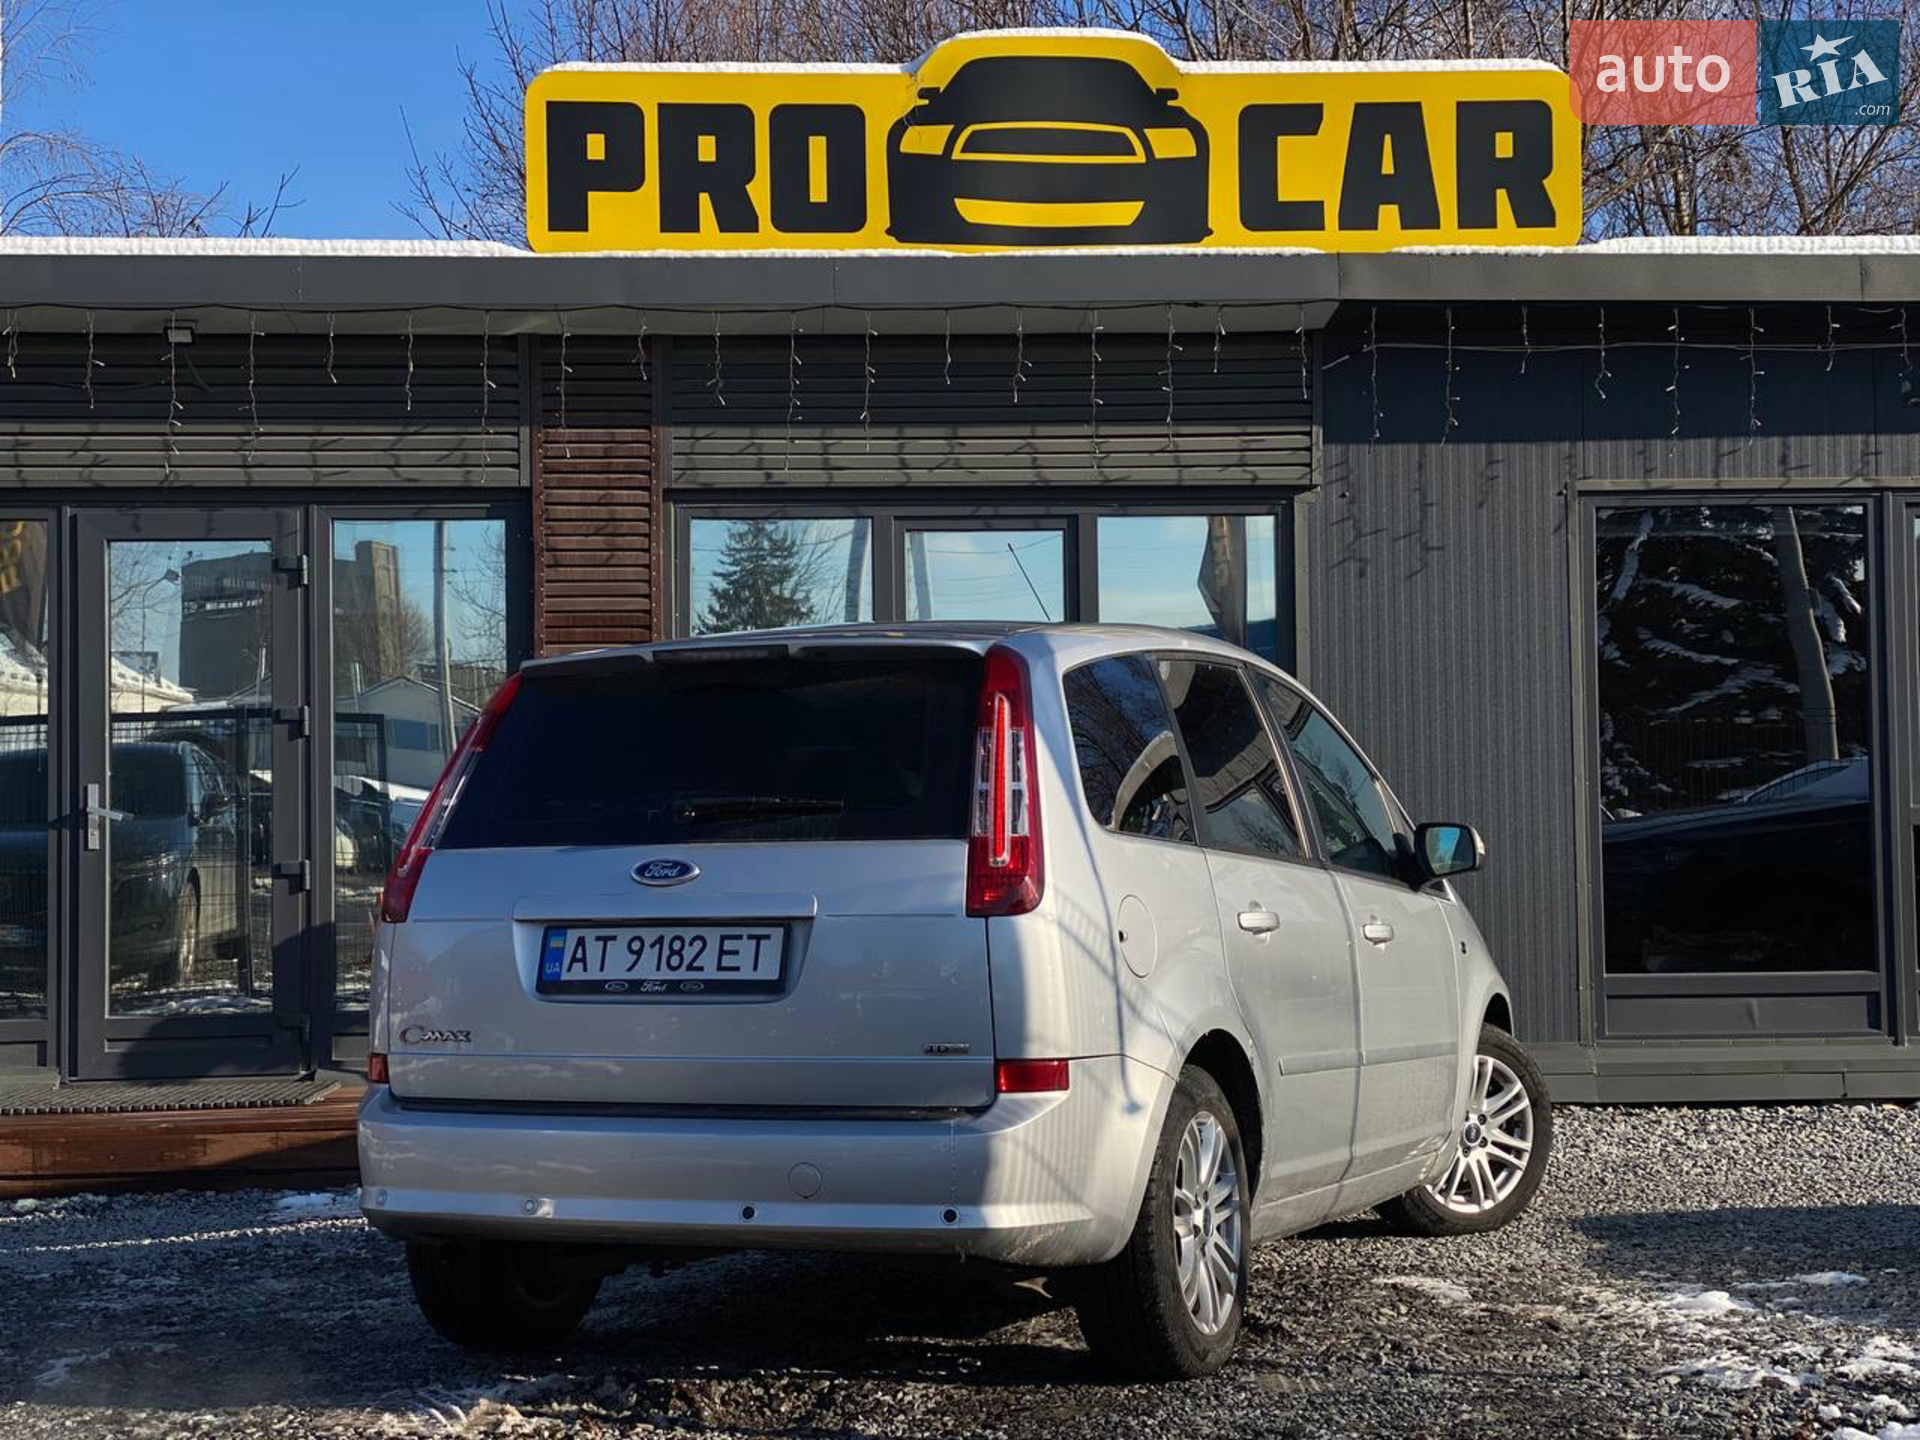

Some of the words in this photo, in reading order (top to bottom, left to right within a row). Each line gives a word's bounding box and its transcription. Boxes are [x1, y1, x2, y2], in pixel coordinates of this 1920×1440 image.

[547, 102, 865, 232] PRO
[1238, 100, 1556, 231] CAR
[644, 862, 680, 878] Ford
[566, 936, 616, 972] AT
[626, 935, 708, 972] 9182
[716, 934, 771, 972] ET
